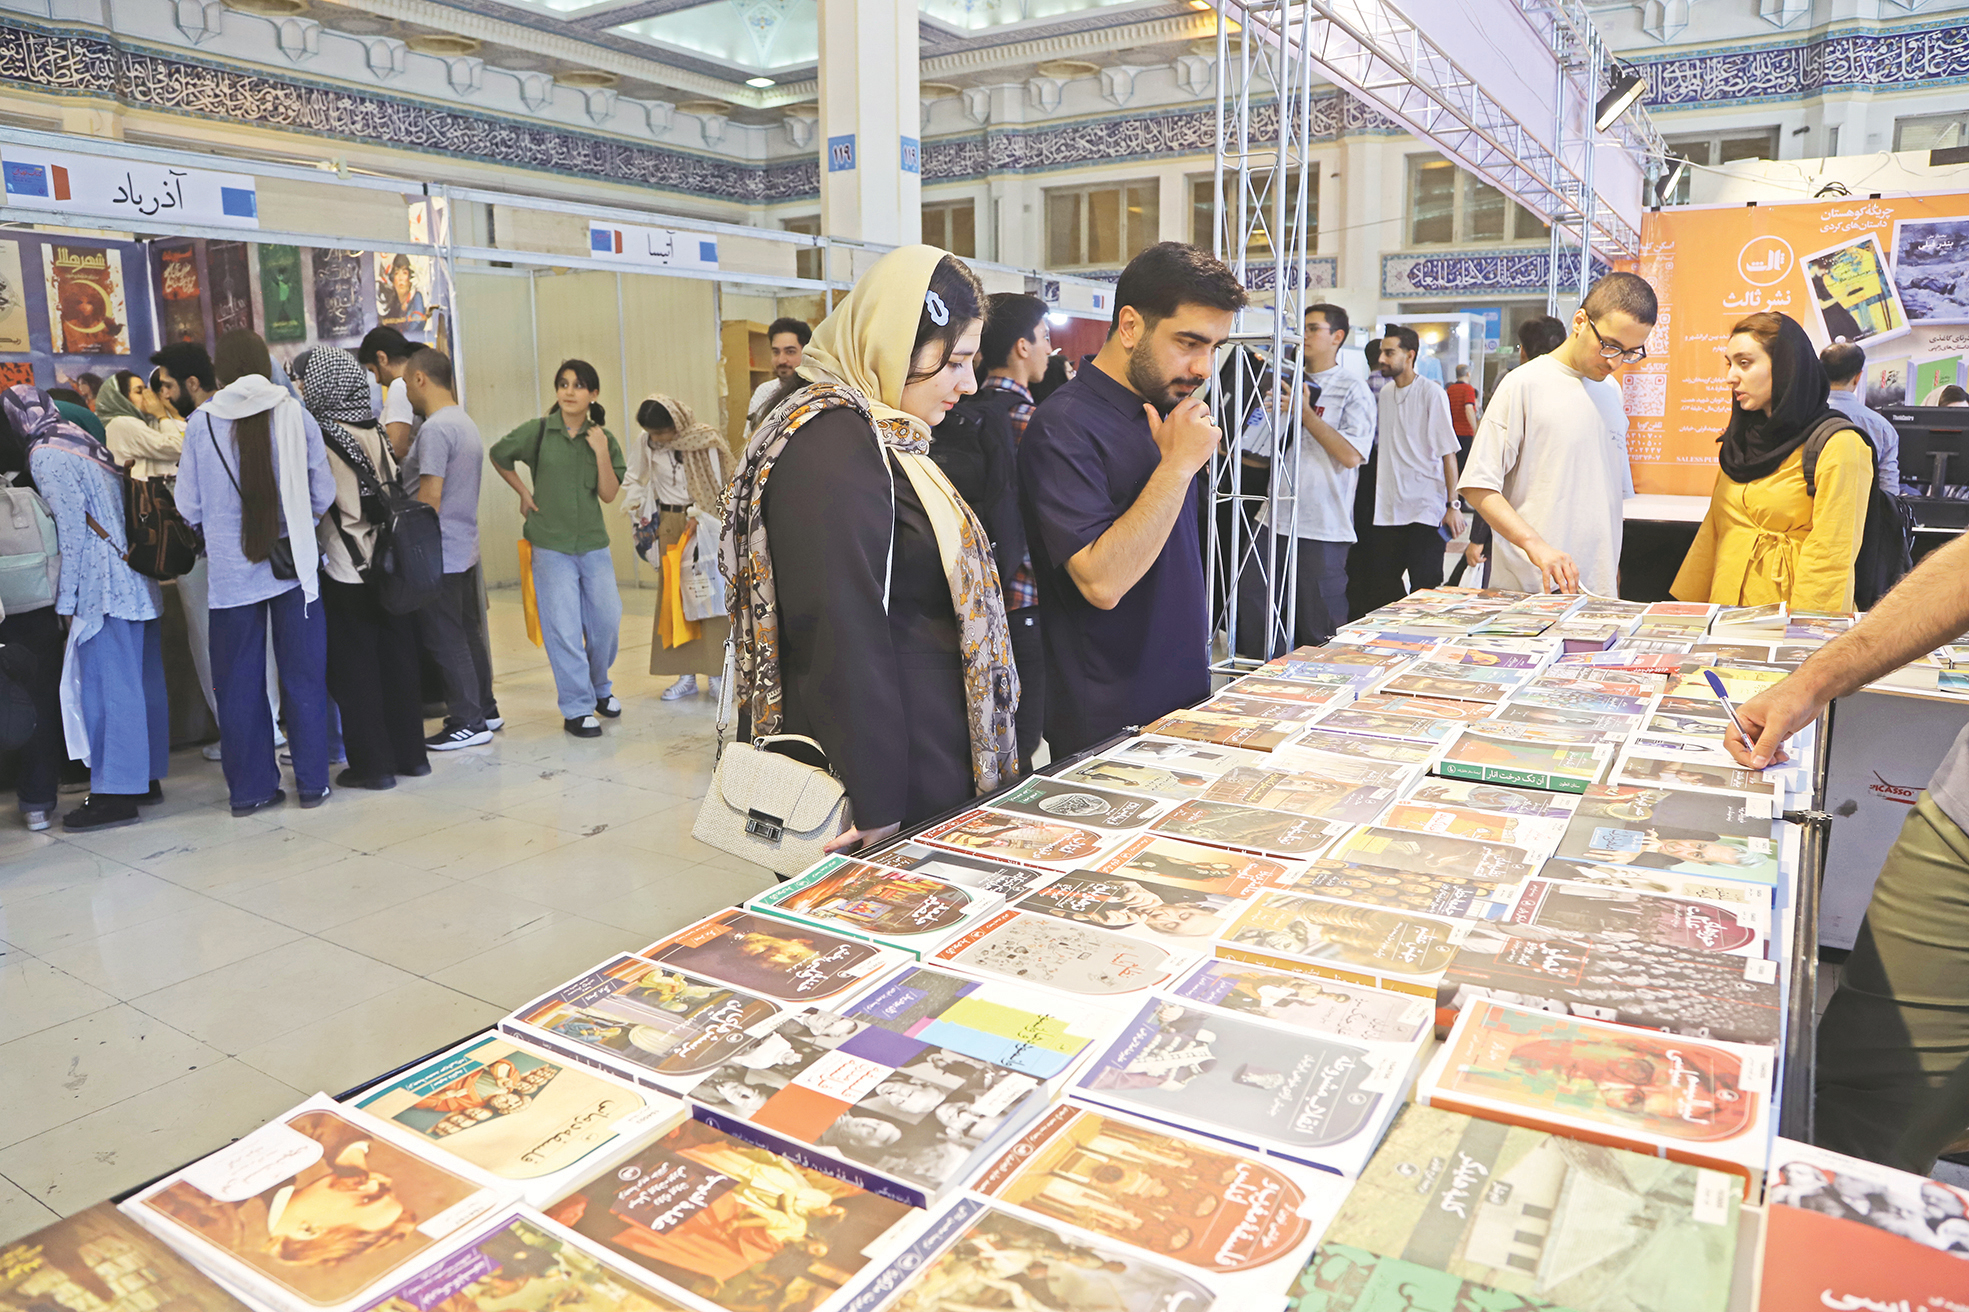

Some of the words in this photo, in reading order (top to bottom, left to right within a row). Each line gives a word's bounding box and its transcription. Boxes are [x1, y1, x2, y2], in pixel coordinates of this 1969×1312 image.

[832, 143, 853, 164] ۱۱۹
[903, 144, 919, 166] ۱۱۹
[112, 169, 187, 215] آذرباد
[1820, 206, 1866, 221] کوهستان
[1819, 222, 1843, 233] کردی
[1938, 240, 1954, 249] بندر
[1722, 288, 1762, 308] ثالث
[1766, 290, 1791, 311] نشر
[1487, 770, 1498, 780] انار
[1500, 773, 1520, 783] درخت
[1523, 774, 1536, 783] تک
[1537, 775, 1546, 786] آن
[1056, 837, 1092, 854] انقلاب
[907, 895, 941, 918] مصرفی
[910, 903, 955, 926] جامعهٔ
[1682, 906, 1706, 929] عدالت
[1412, 926, 1433, 945] عظیم
[1537, 942, 1572, 975] تمایز
[705, 999, 747, 1023] ایمان
[1113, 1050, 1132, 1063] علیرضا
[809, 1058, 864, 1089] فرانسه
[1309, 1054, 1356, 1096] مشروطه
[1666, 1049, 1693, 1087] سیاسی
[837, 1067, 888, 1098] فلسفهٔ
[1265, 1098, 1289, 1117] جنبش
[1678, 1075, 1709, 1124] لیبرالیسم
[1290, 1094, 1331, 1135] انقلاب
[518, 1129, 573, 1165] فلسفه
[567, 1099, 621, 1132] درمانی
[781, 1151, 810, 1168] فرانسه
[811, 1163, 835, 1179] مدرن
[836, 1170, 864, 1188] فلسفهٔ
[1449, 1151, 1483, 1191] هایدگر
[616, 1185, 639, 1199] ترجمهٔ
[1220, 1163, 1261, 1204] اندلس
[1258, 1177, 1279, 1190] و
[1237, 1188, 1276, 1223] مغرب
[1443, 1188, 1471, 1218] کلبهٔ
[645, 1200, 695, 1232] عقدهٔ
[1267, 1210, 1290, 1229] نوین
[1212, 1221, 1263, 1268] فلسفهٔ
[1257, 1228, 1281, 1249] خوانشی
